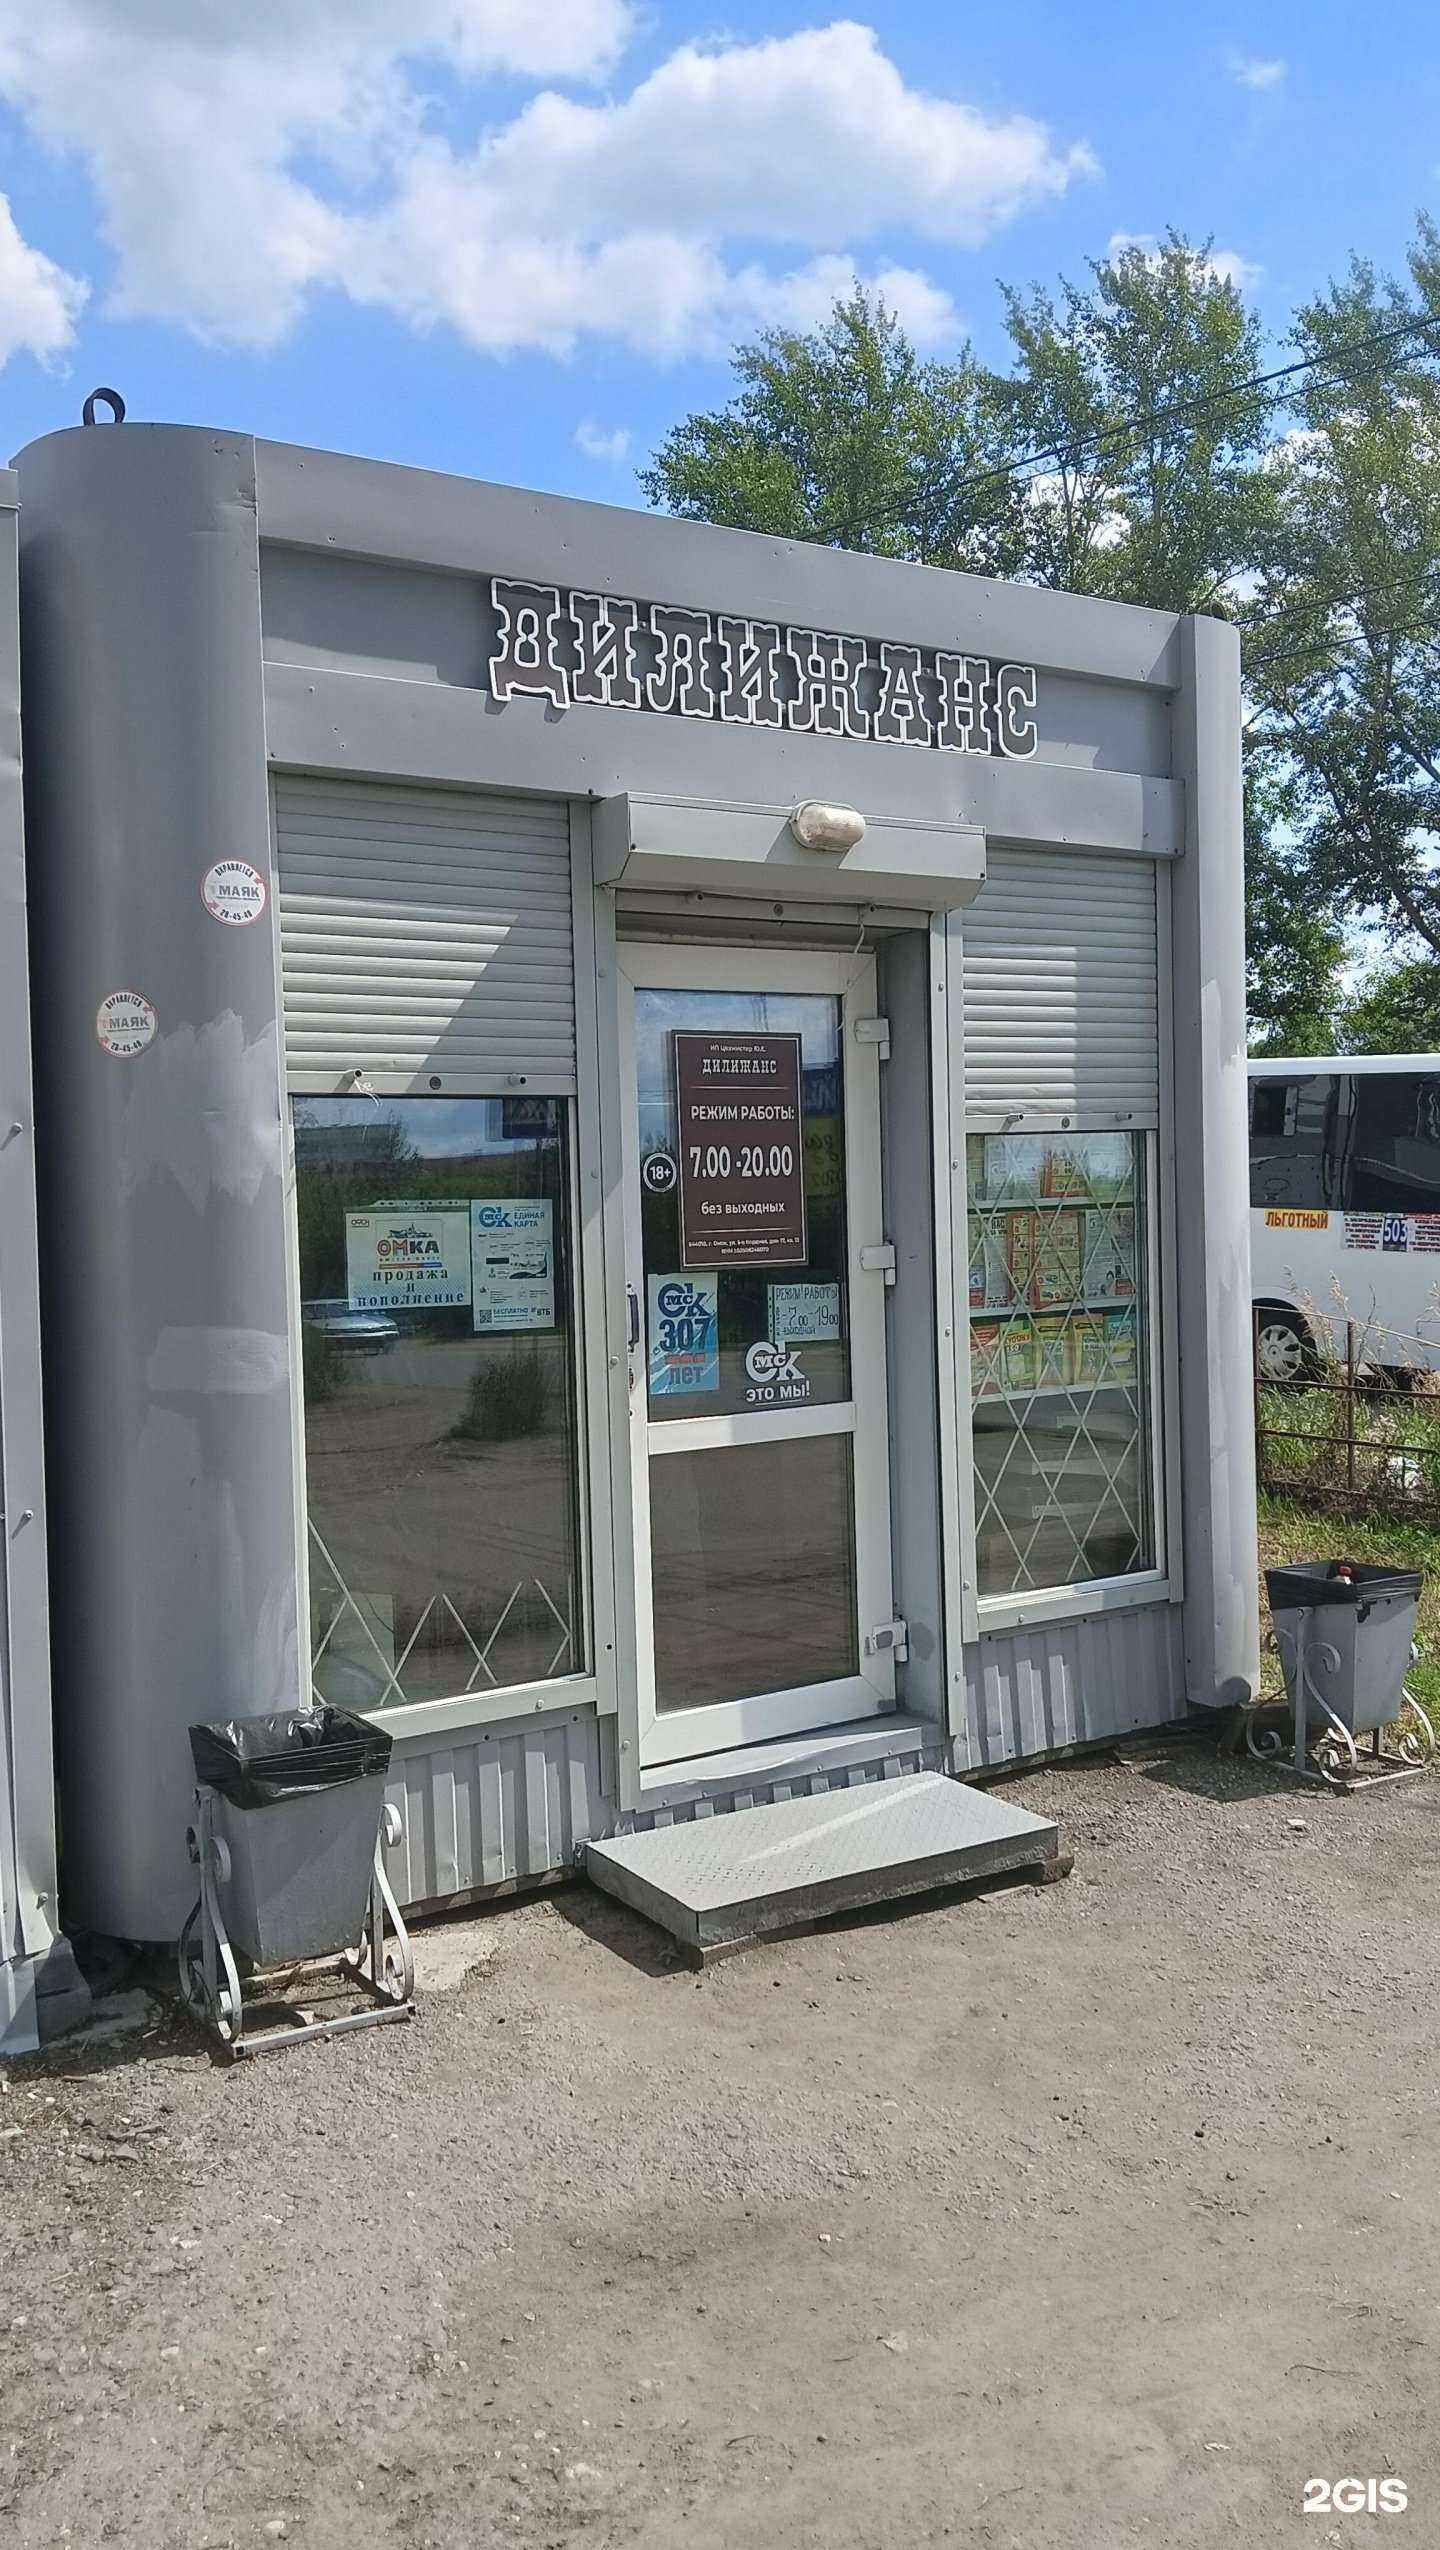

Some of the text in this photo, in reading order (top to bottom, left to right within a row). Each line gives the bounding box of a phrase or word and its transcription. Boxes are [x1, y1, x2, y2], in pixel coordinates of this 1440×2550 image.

[488, 576, 1038, 760] ДИЛИЖАНС
[218, 885, 260, 898] МАЯК
[110, 1016, 149, 1028] МАЯК
[702, 1059, 777, 1075] ДИЛИЖАНС
[691, 1105, 795, 1120] РЕЖИМ РАБОТЫ:
[689, 1145, 731, 1178] 7.00
[649, 1165, 672, 1180] 18+
[701, 1201, 785, 1214] без выходных
[513, 1211, 545, 1220] ЕДИНАЯ
[1264, 1210, 1329, 1229] ЛЬГОТНЫЙ
[513, 1220, 538, 1228] КАРТА
[1384, 1219, 1408, 1242] 503
[377, 1239, 440, 1257] ОМКА
[373, 1269, 449, 1285] продажа
[406, 1283, 415, 1292] и
[804, 1285, 839, 1300] РАБОТЫ
[357, 1292, 465, 1307] пополнение
[658, 1318, 709, 1353] 307
[667, 1366, 704, 1386] лет
